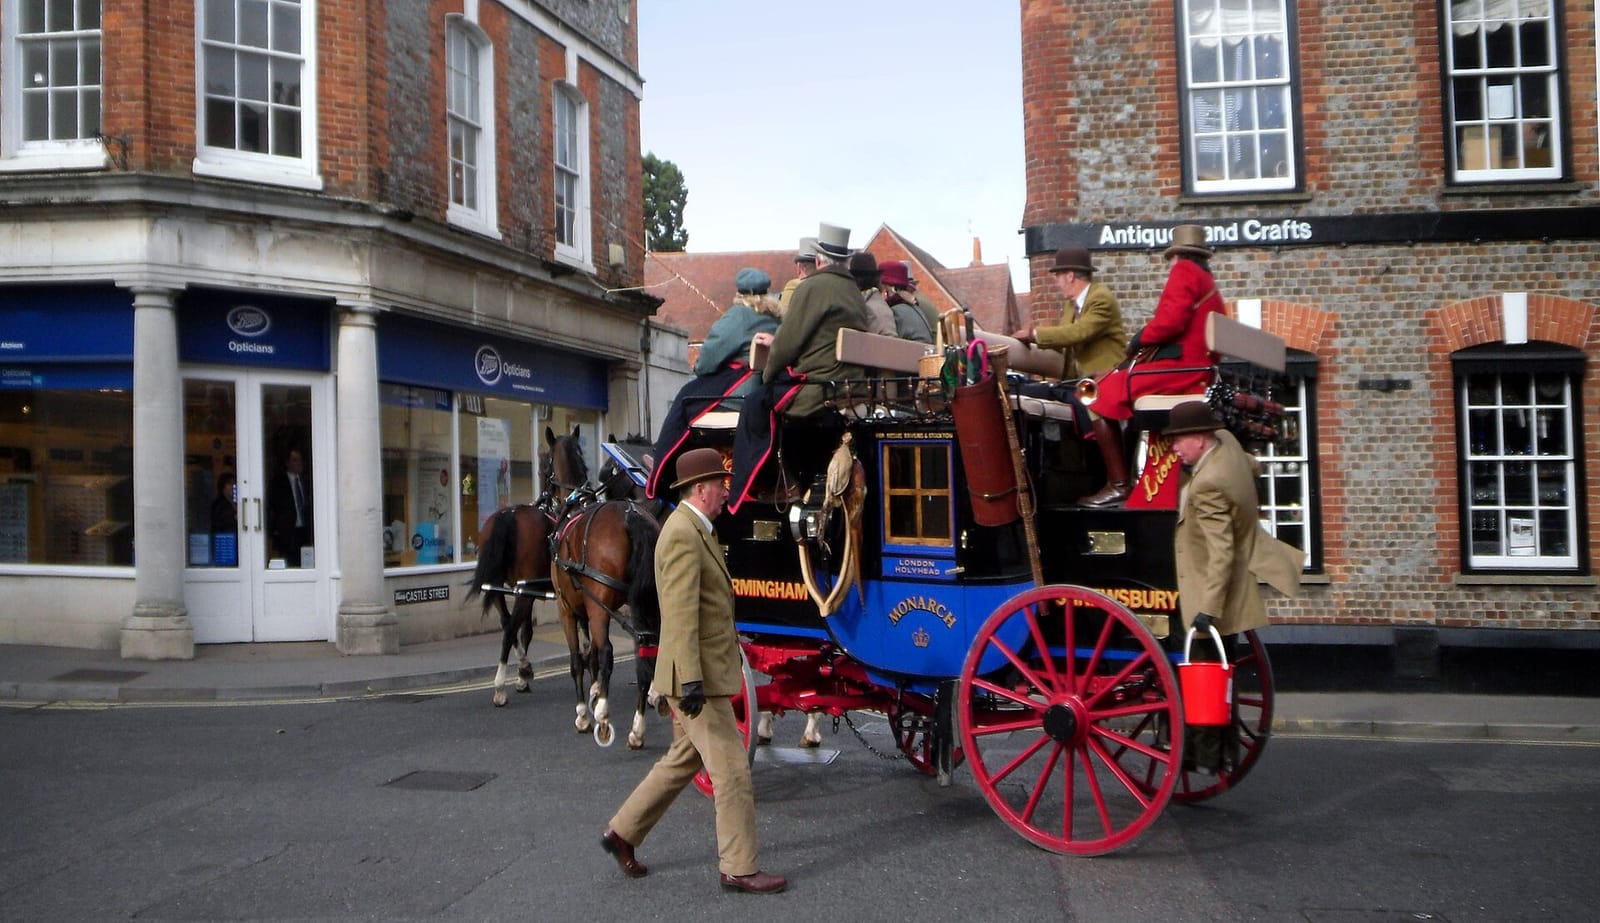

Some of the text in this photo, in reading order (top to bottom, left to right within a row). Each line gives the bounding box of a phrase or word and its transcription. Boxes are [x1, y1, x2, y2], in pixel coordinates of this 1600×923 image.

[1100, 218, 1313, 246] Antiqu and Crafts
[228, 340, 274, 354] Opticians
[503, 362, 531, 379] Opticians
[1143, 453, 1178, 502] Lion
[895, 566, 941, 576] HOLYHEAD
[899, 559, 936, 568] LONDON
[406, 589, 428, 602] CASTLE
[429, 587, 449, 600] STREET
[732, 578, 809, 601] RMINGHAM
[888, 595, 957, 629] MONARCH
